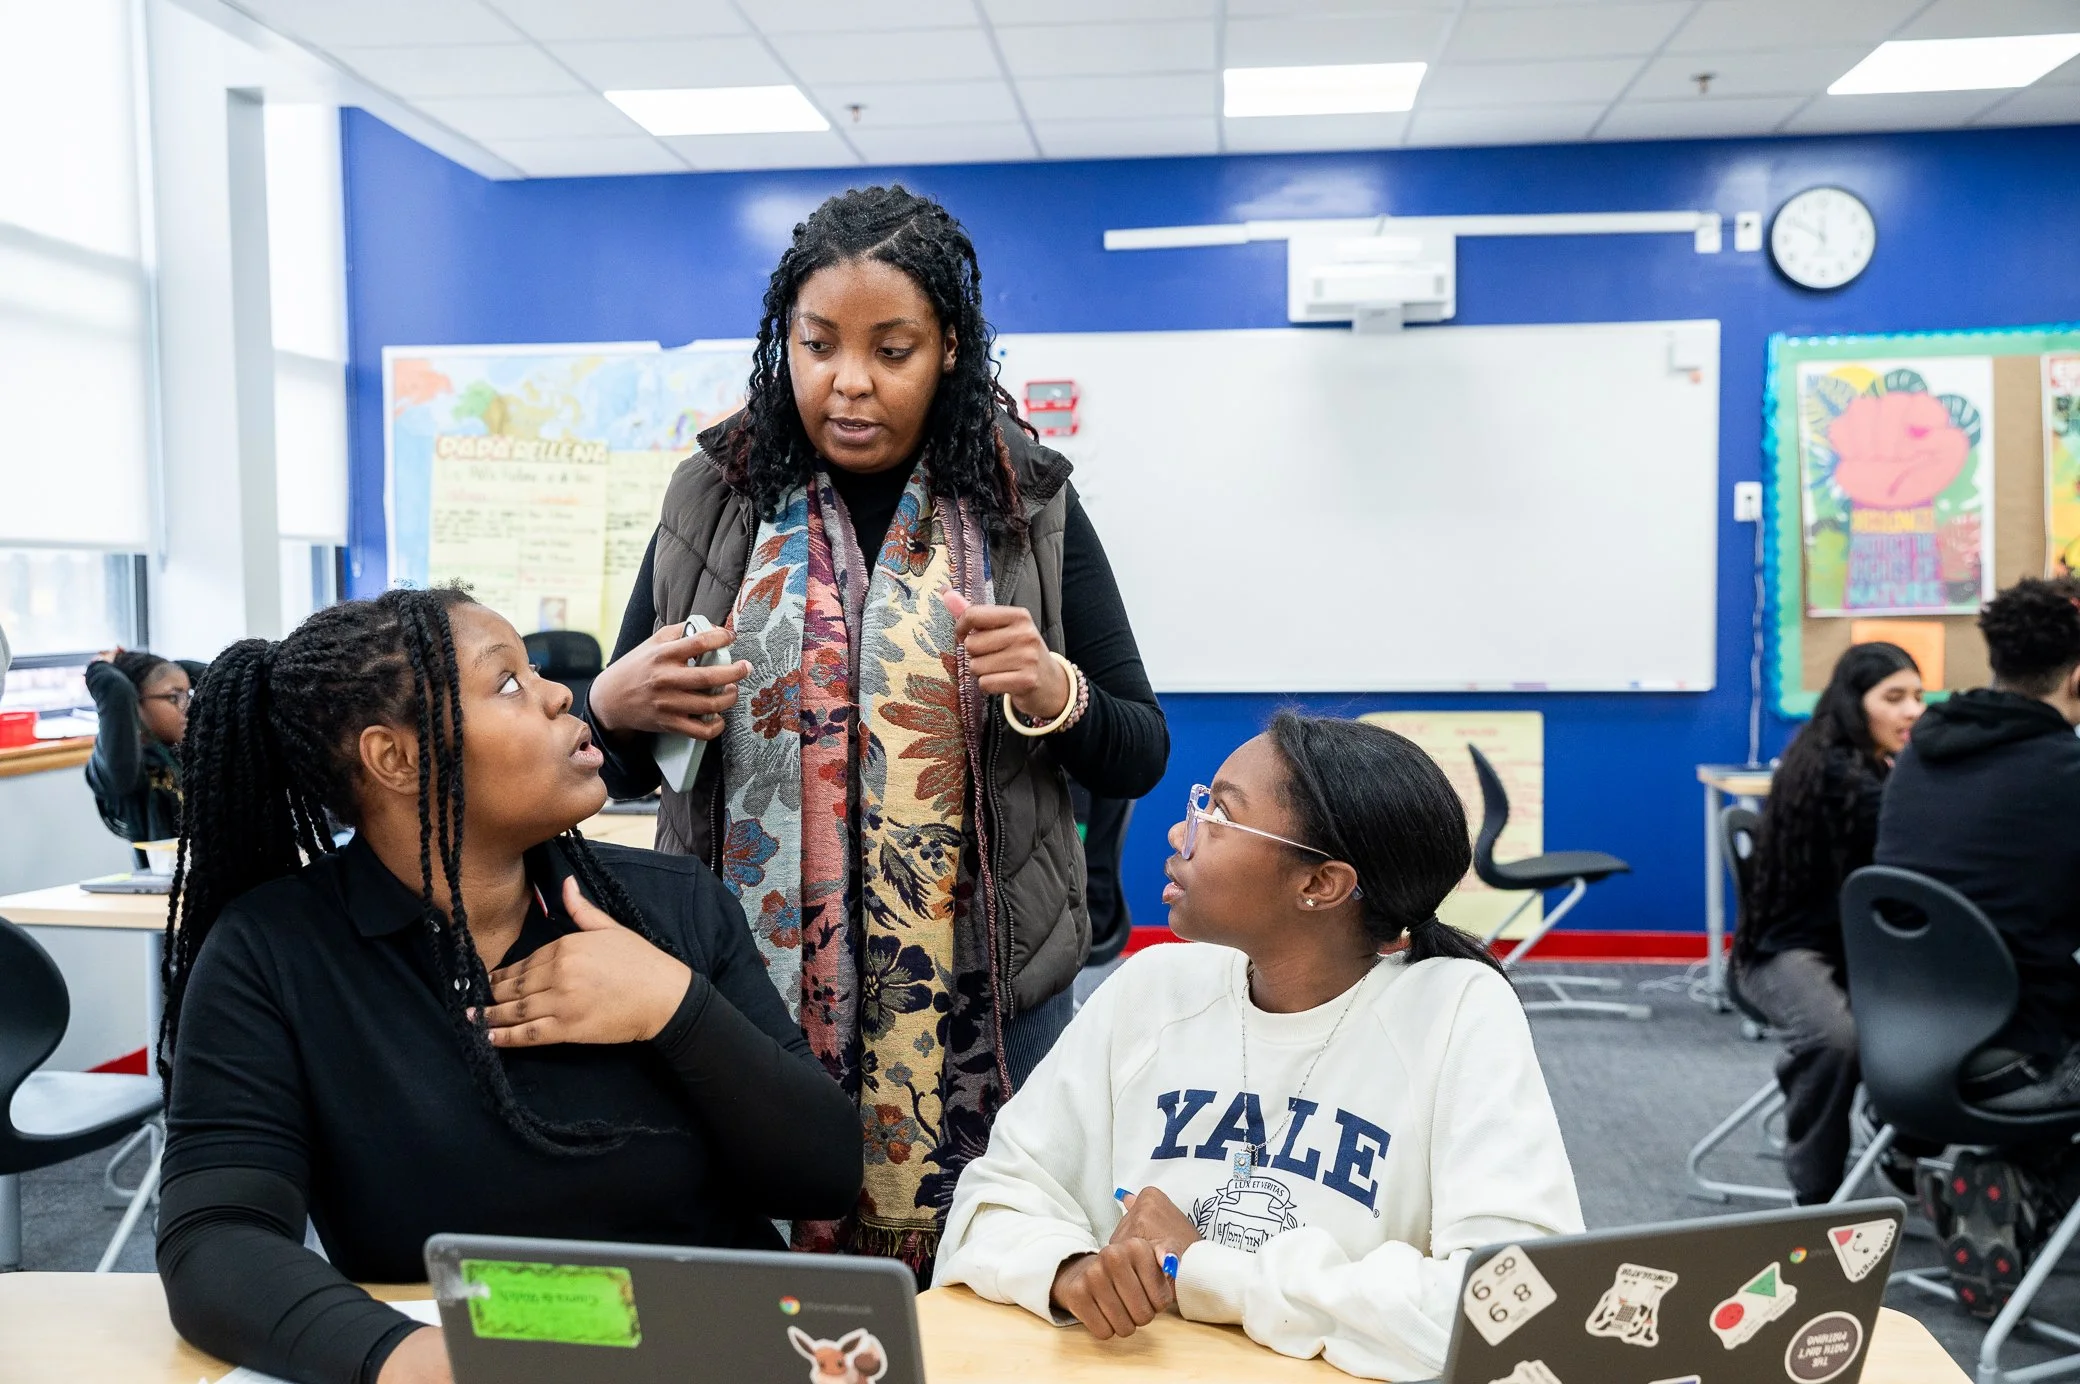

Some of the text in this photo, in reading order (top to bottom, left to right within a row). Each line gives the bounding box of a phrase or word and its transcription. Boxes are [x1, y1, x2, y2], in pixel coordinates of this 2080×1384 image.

[437, 435, 511, 461] PAPA
[1151, 1089, 1391, 1211] YALE
[1235, 1181, 1251, 1189] LUX
[1261, 1181, 1284, 1197] VERITAS
[1806, 1331, 1848, 1346] MATHING
[1823, 1342, 1849, 1356] MATH
[1811, 1356, 1828, 1368] THE
